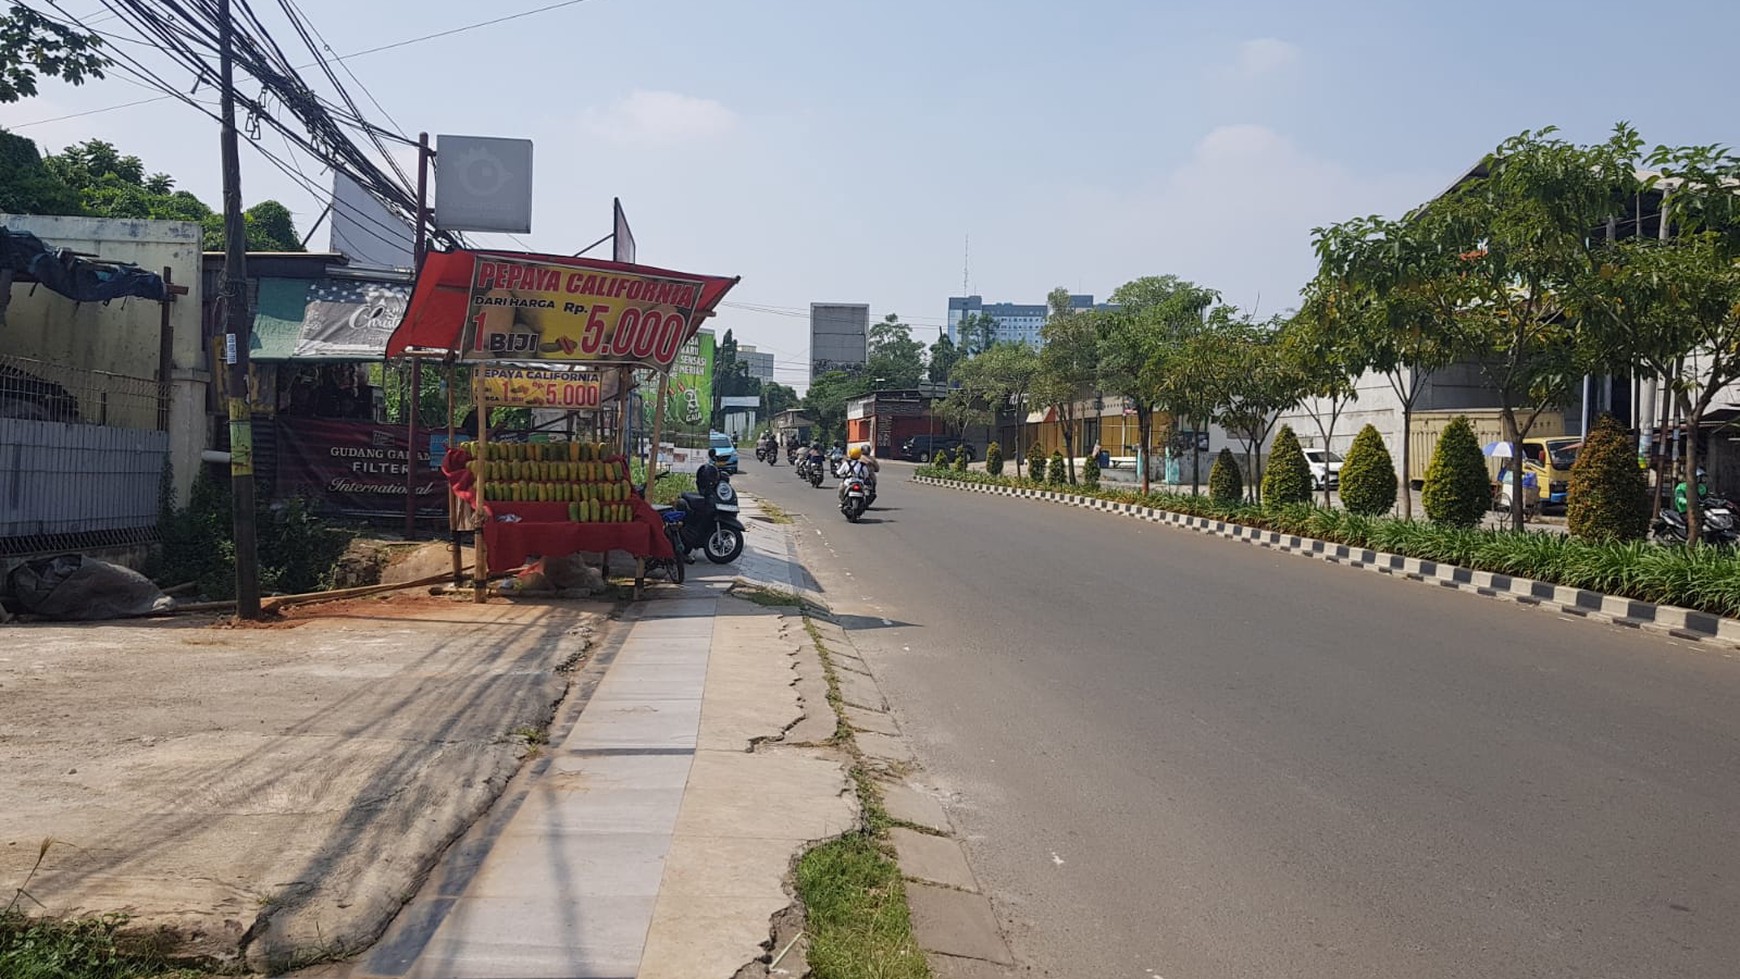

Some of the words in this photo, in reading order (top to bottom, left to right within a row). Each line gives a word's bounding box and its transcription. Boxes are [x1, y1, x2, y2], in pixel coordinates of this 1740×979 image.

[478, 262, 562, 292] PEPAYA
[565, 273, 696, 308] CALIFORNIA
[473, 312, 487, 352] 1
[489, 333, 539, 352] BIJI
[474, 296, 507, 306] DARI
[510, 297, 555, 309] HARGA
[563, 302, 588, 316] Rp.
[581, 304, 687, 366] 5.000
[475, 368, 524, 379] EPAYA
[526, 371, 599, 382] CALIFORNIA
[546, 383, 598, 406] 5.000
[330, 447, 384, 459] GUDANG
[352, 461, 409, 474] FILTER
[328, 477, 434, 496] Internatioal
